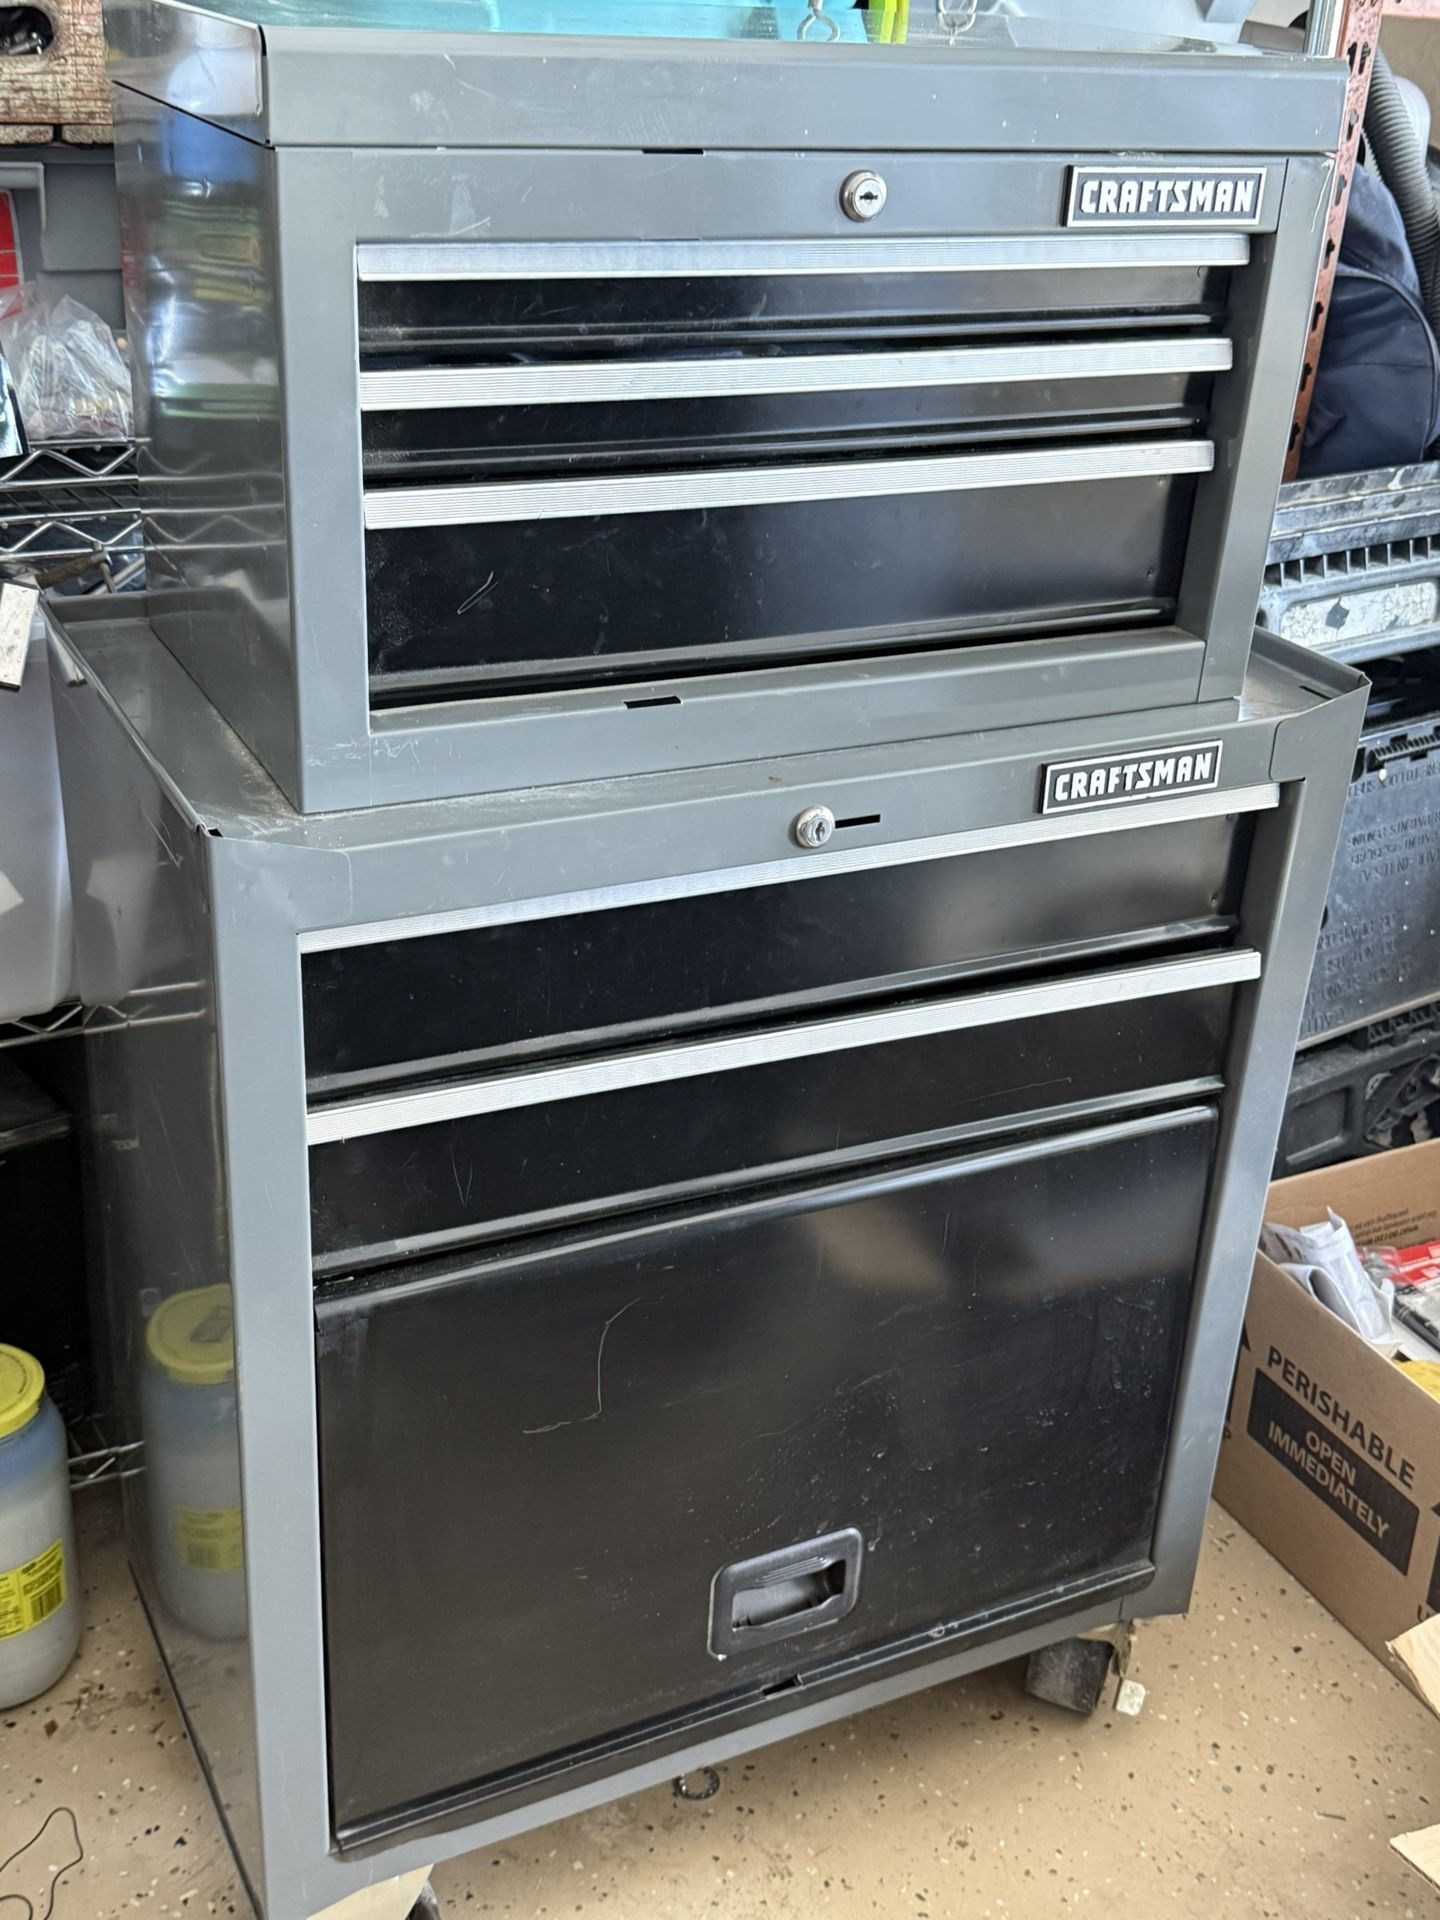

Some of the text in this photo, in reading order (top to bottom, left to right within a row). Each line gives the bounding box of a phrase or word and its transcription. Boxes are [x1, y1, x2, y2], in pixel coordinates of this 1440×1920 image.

[1081, 179, 1255, 213] CRAFTSMAN
[1054, 752, 1213, 801] CRAFTSMAN
[1267, 1345, 1415, 1490] PERISHABLE
[1268, 1421, 1390, 1539] IMMEDIATELY
[1305, 1431, 1356, 1486] OPEN
